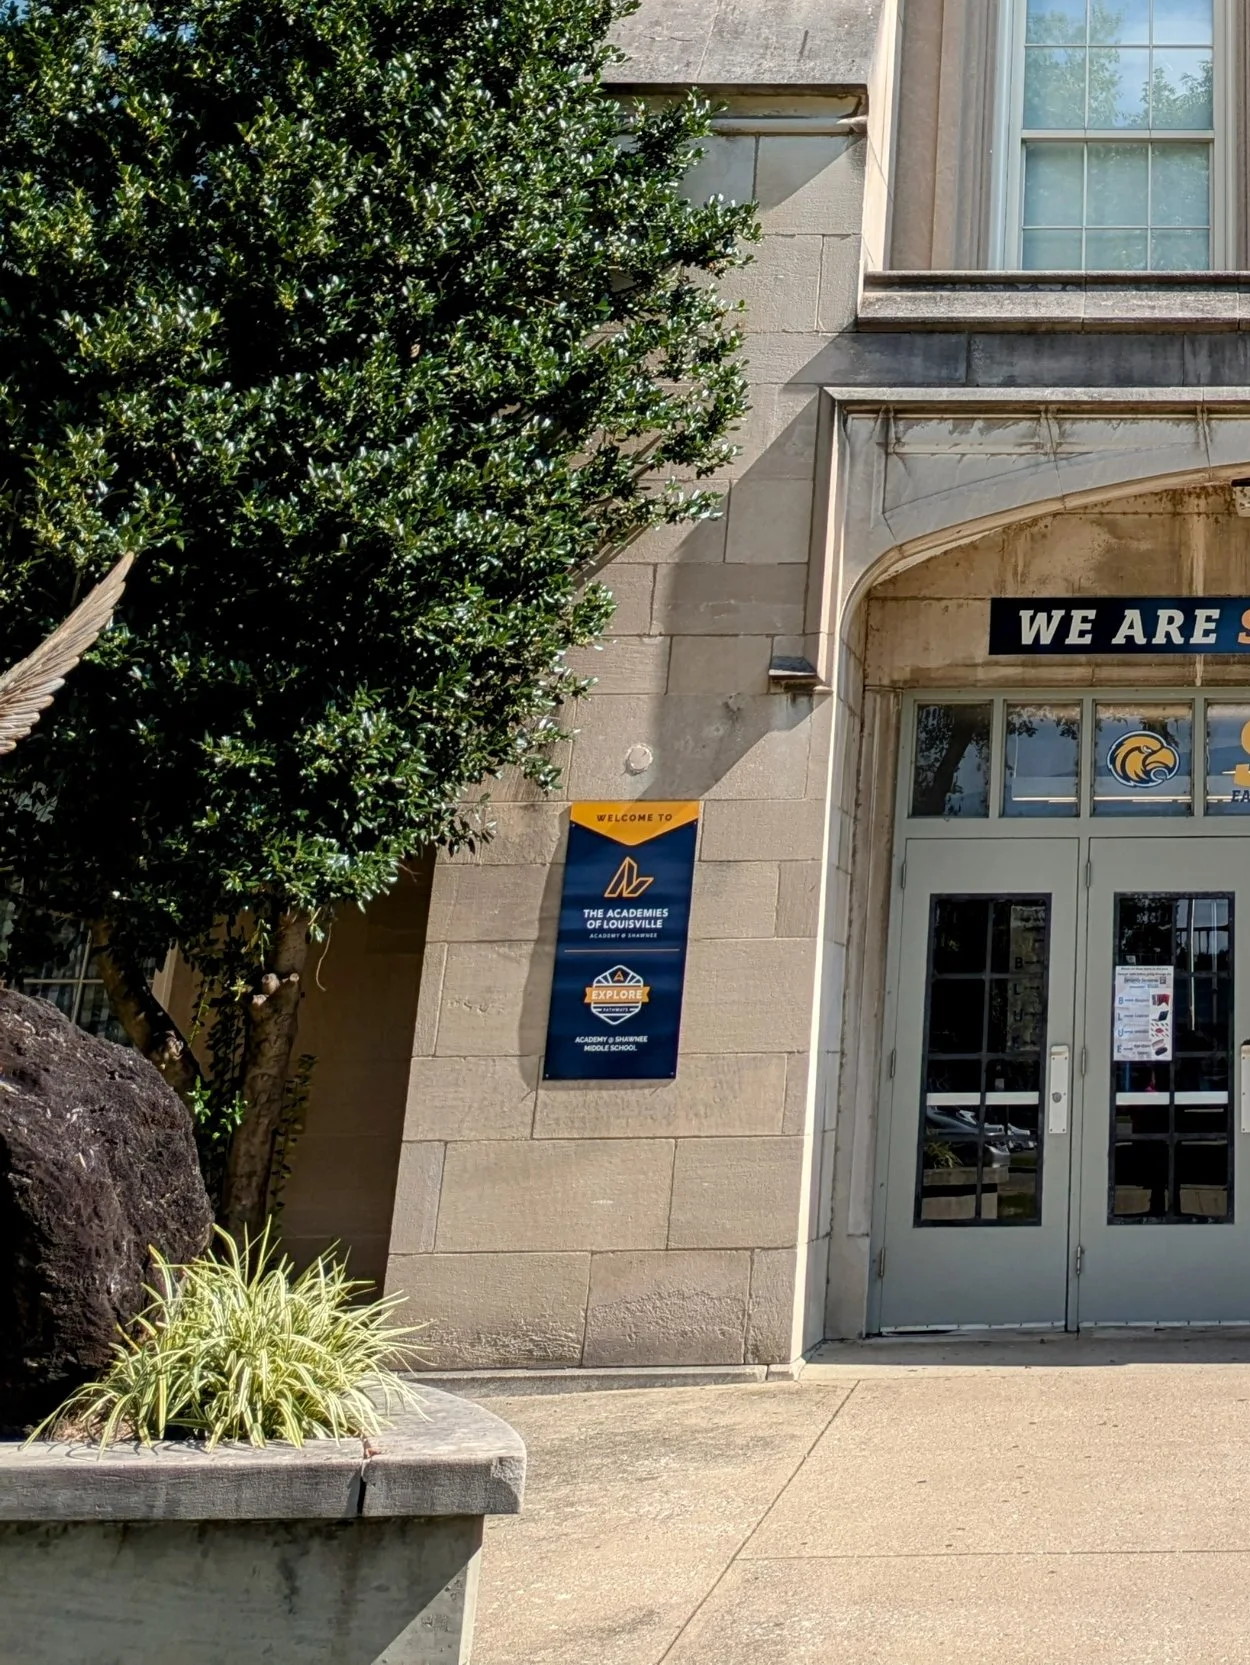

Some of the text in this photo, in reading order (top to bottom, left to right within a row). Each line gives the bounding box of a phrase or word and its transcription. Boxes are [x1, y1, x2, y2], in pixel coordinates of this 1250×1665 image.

[1018, 608, 1097, 645] WE
[1110, 608, 1221, 645] ARE
[596, 813, 673, 822] WELCOME TO
[583, 908, 669, 918] THE ACADEMIES
[587, 919, 663, 929] OF LOUISVILLE
[591, 989, 643, 1000] EXPLORE
[583, 1044, 610, 1052] MIDDLE
